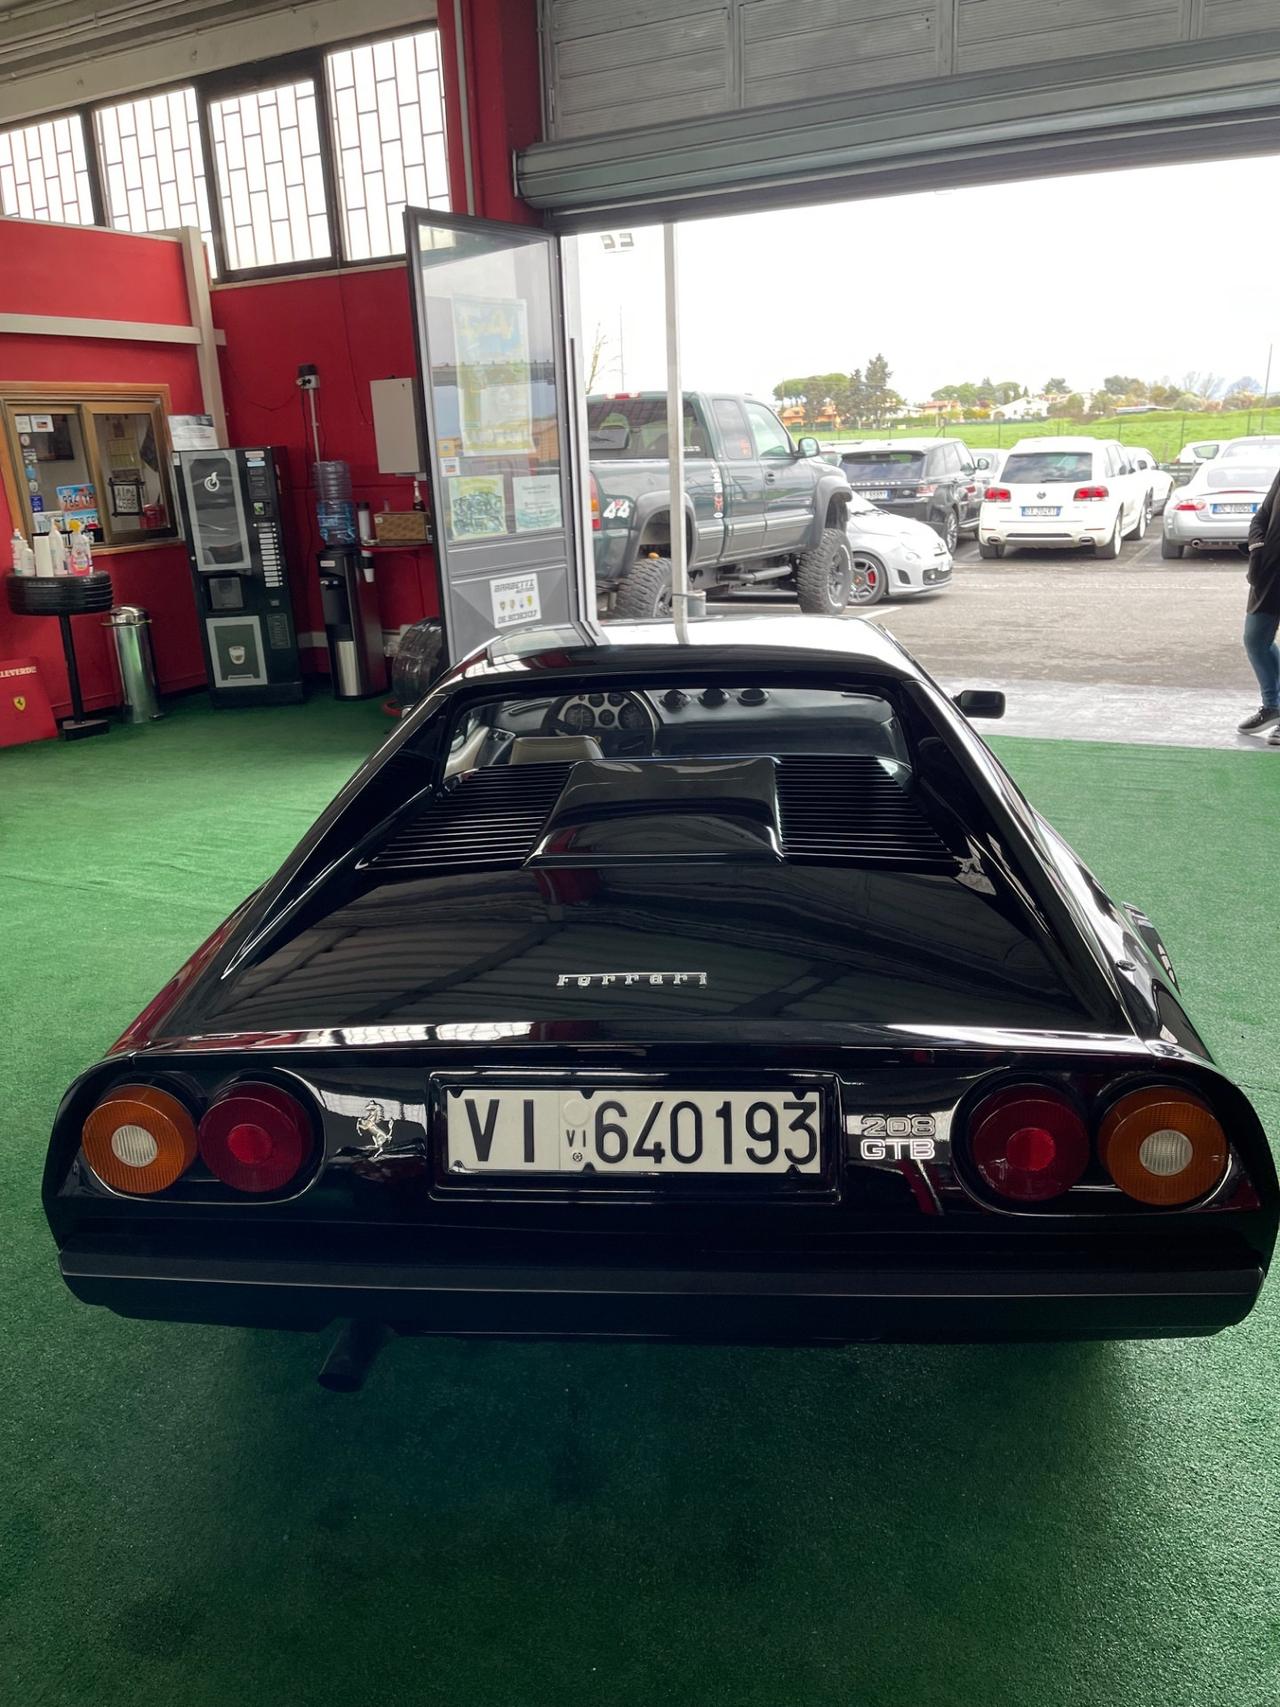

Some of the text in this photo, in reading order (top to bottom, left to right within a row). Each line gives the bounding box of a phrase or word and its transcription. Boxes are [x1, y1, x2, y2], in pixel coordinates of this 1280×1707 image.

[0, 666, 37, 678] LEVERDE
[556, 972, 707, 986] Ferrari
[464, 1099, 818, 1165] VI 640193
[860, 1115, 936, 1137] 208
[566, 1129, 587, 1148] VI
[860, 1138, 936, 1160] GTB
